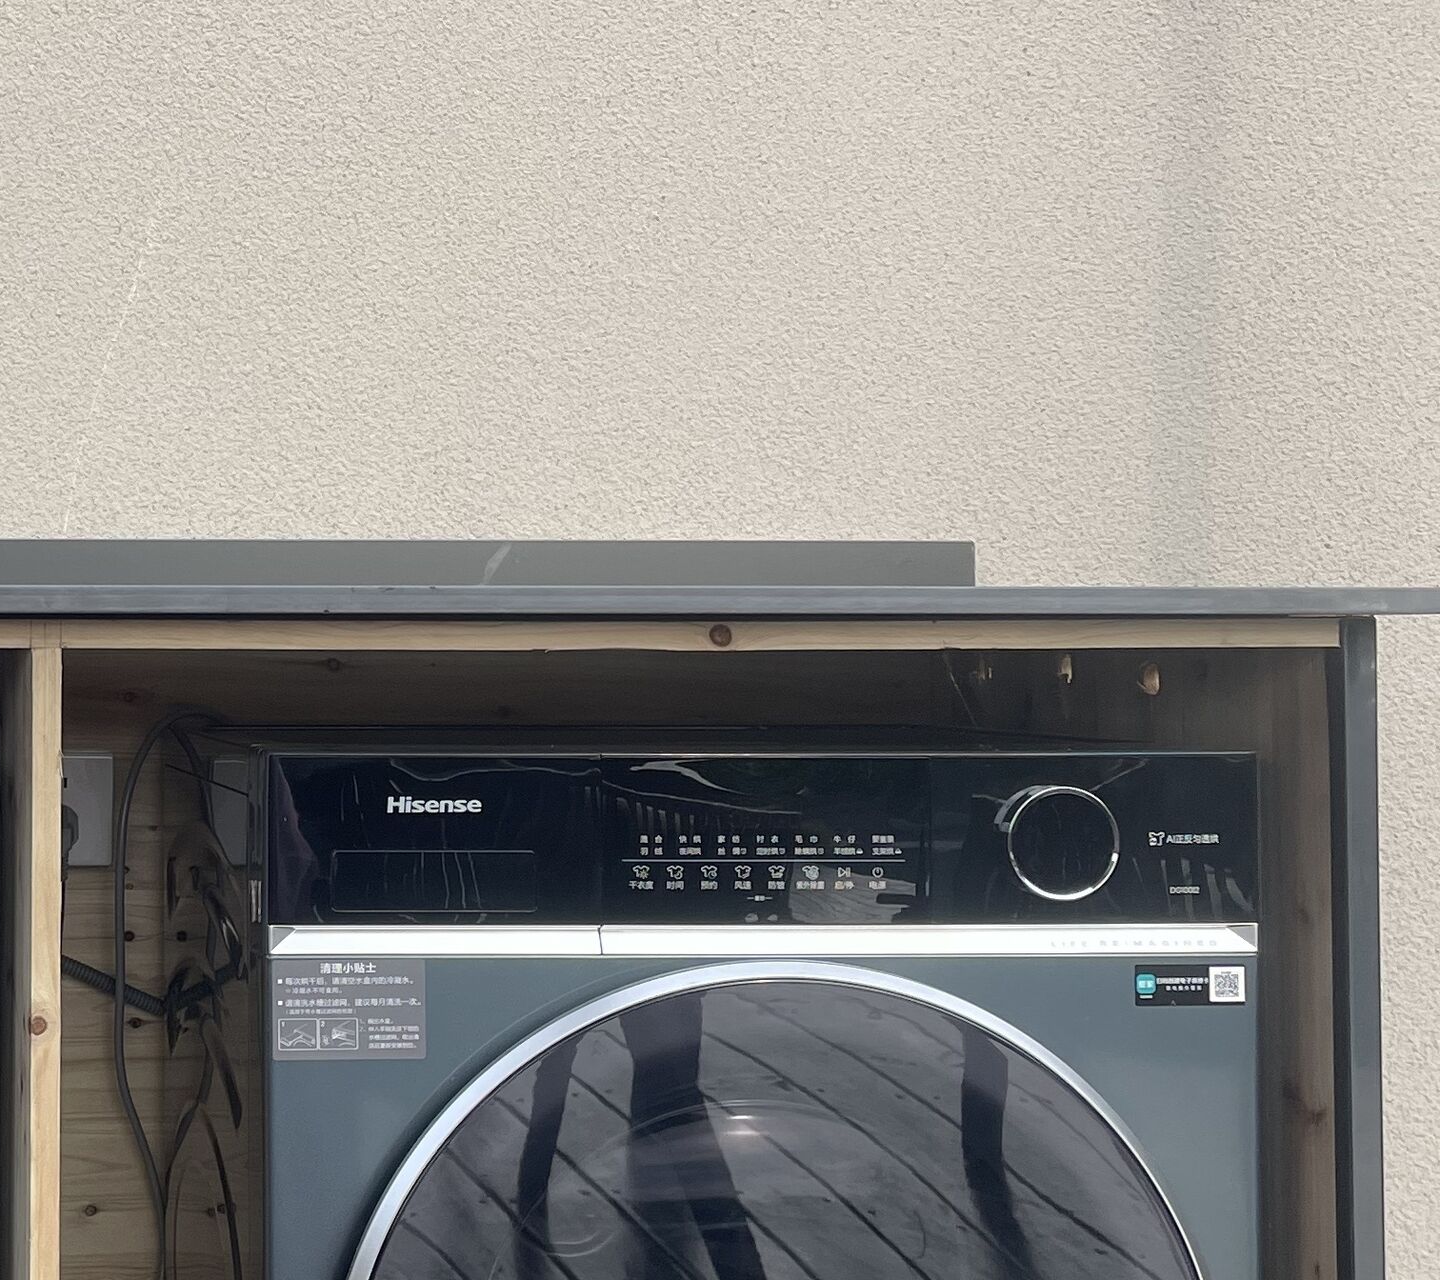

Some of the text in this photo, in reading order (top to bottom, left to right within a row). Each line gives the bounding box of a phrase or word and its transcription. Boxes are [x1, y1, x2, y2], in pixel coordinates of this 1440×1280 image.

[386, 796, 482, 813] Hisense
[666, 880, 685, 890] 时间
[320, 962, 377, 974] 清理小贴士
